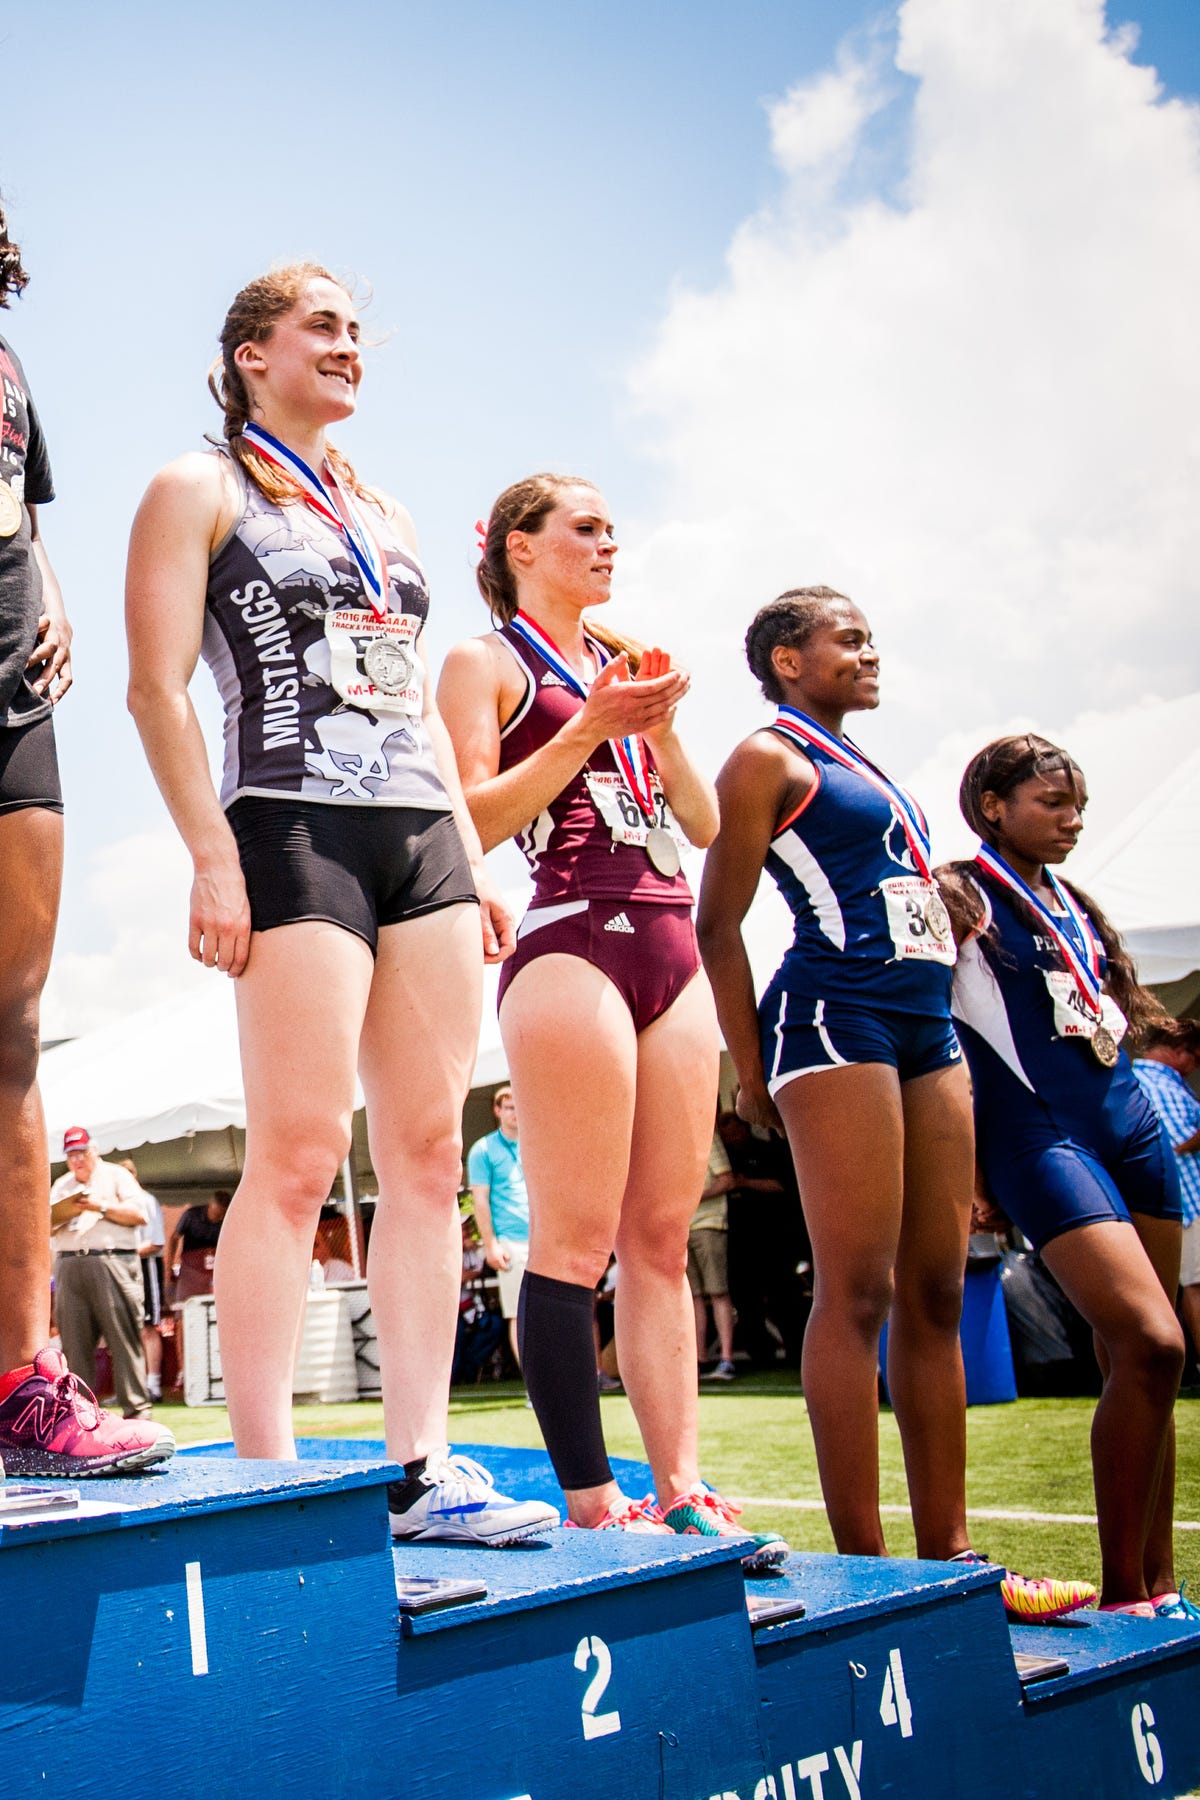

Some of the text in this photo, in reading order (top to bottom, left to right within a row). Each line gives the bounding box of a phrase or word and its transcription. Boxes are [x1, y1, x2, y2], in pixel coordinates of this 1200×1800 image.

[331, 621, 356, 631] TRACK
[335, 611, 360, 622] 2016
[230, 579, 300, 751] MUSTANGS
[615, 790, 671, 830] 62
[604, 922, 635, 934] adidas
[185, 1561, 209, 1676] 1
[573, 1635, 621, 1741] 2
[879, 1648, 913, 1738] 4
[1130, 1702, 1164, 1785] 6
